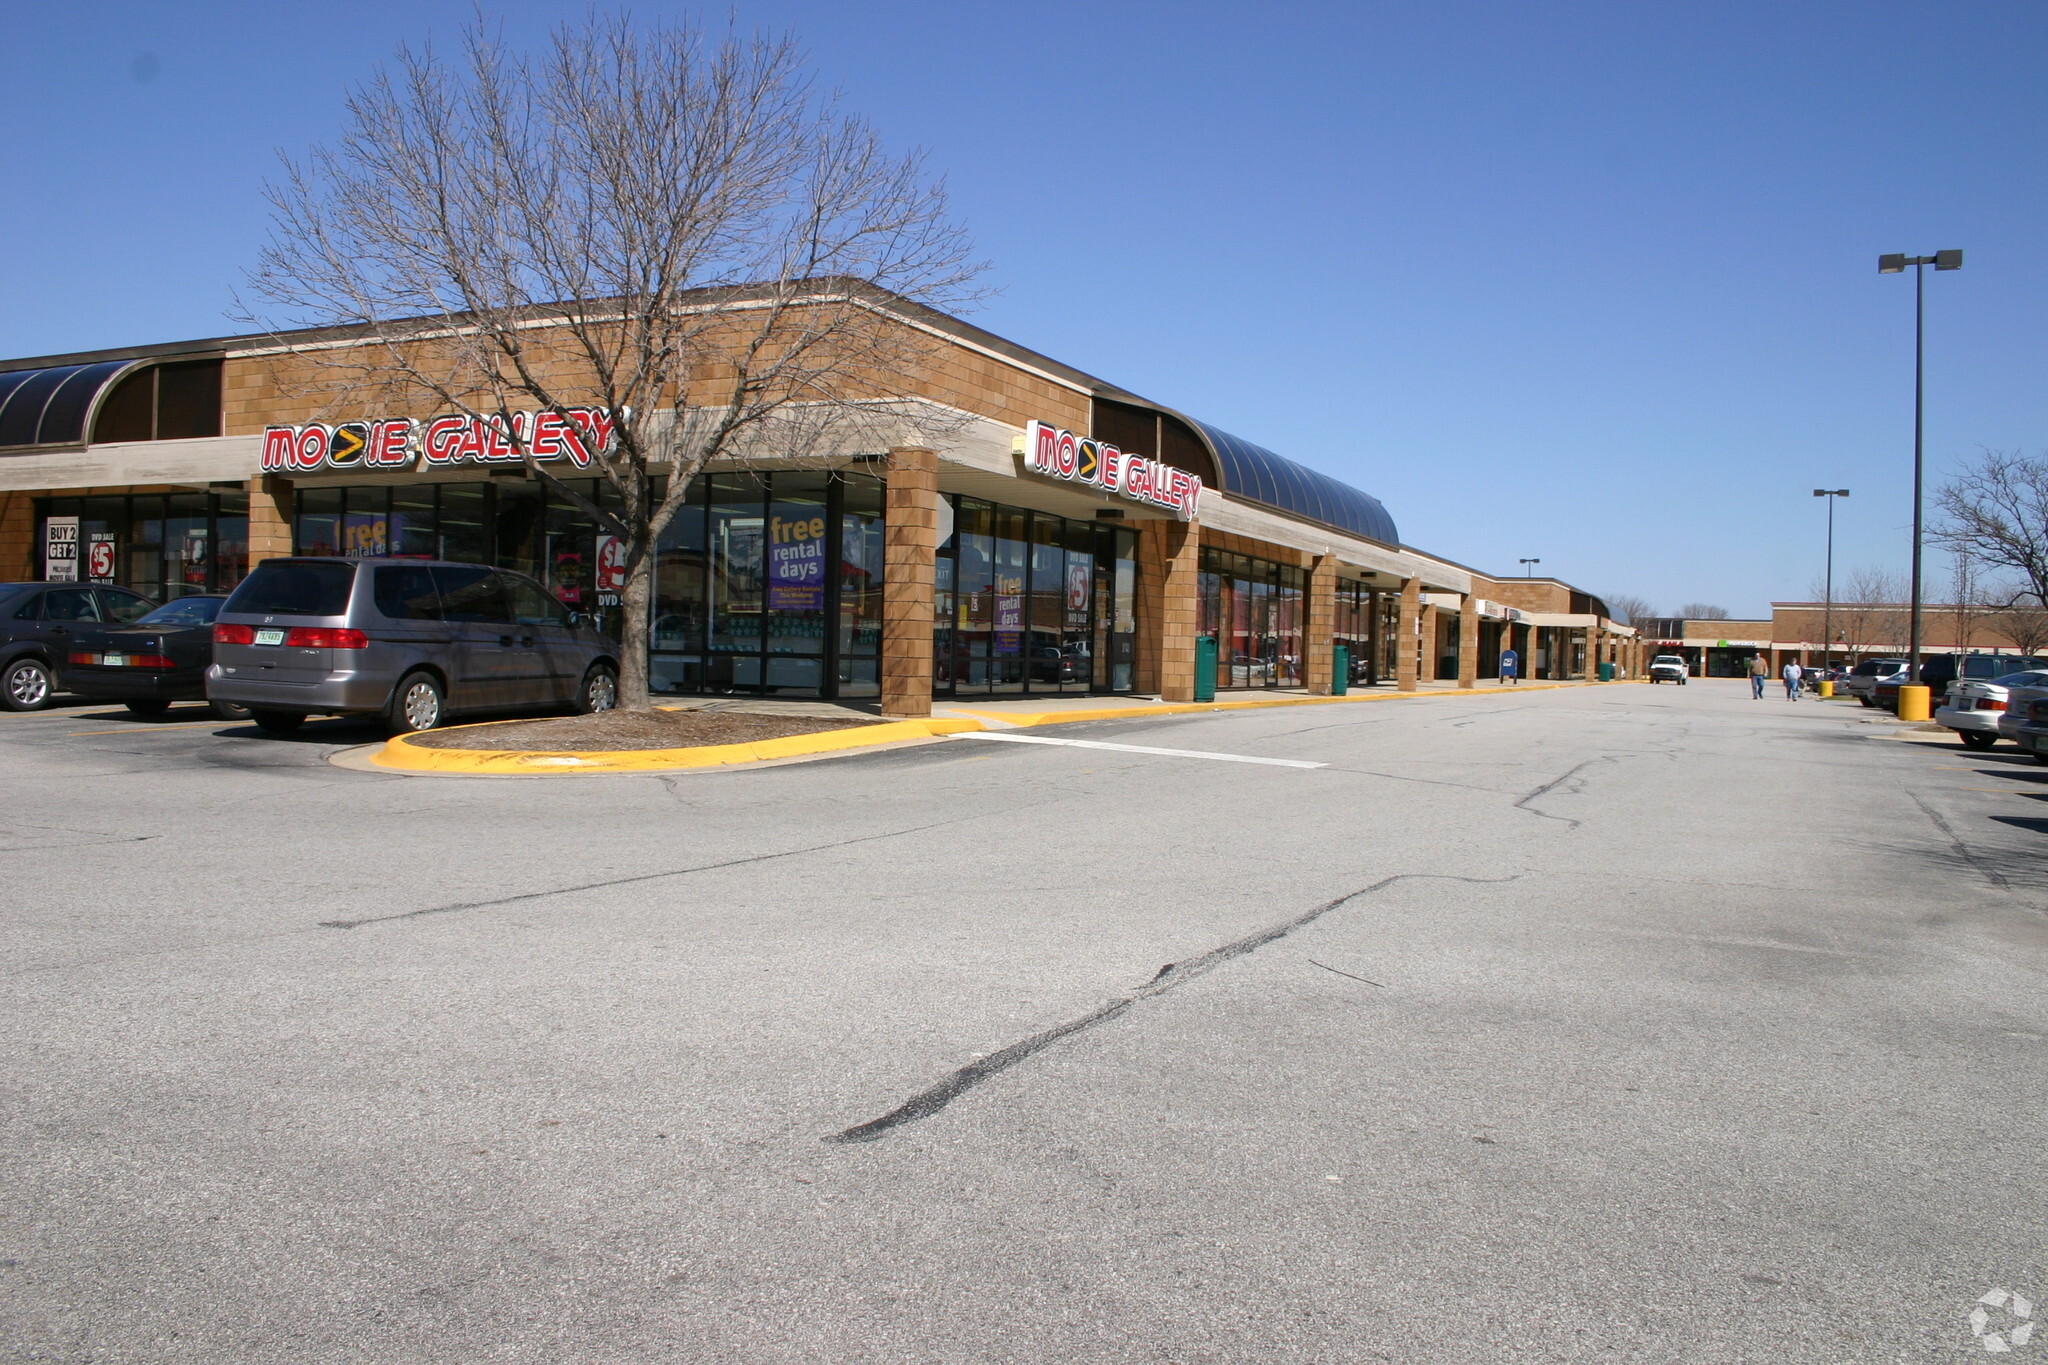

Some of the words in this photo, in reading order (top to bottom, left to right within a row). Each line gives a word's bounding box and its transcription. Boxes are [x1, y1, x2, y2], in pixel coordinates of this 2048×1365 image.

[422, 405, 621, 470] GALLERY
[1125, 453, 1202, 522] GALLERY
[50, 526, 69, 540] BUY
[70, 526, 76, 540] 2
[771, 516, 825, 544] free
[49, 543, 68, 558] GET
[69, 543, 76, 558] 2
[345, 541, 374, 557] ental
[773, 540, 822, 561] rental
[93, 546, 110, 575] $5
[780, 561, 818, 580] days
[936, 569, 950, 580] XIT
[998, 574, 1022, 596] free
[1071, 571, 1085, 607] $5
[598, 594, 619, 606] DVD
[1000, 595, 1021, 611] rental
[1001, 611, 1019, 628] days
